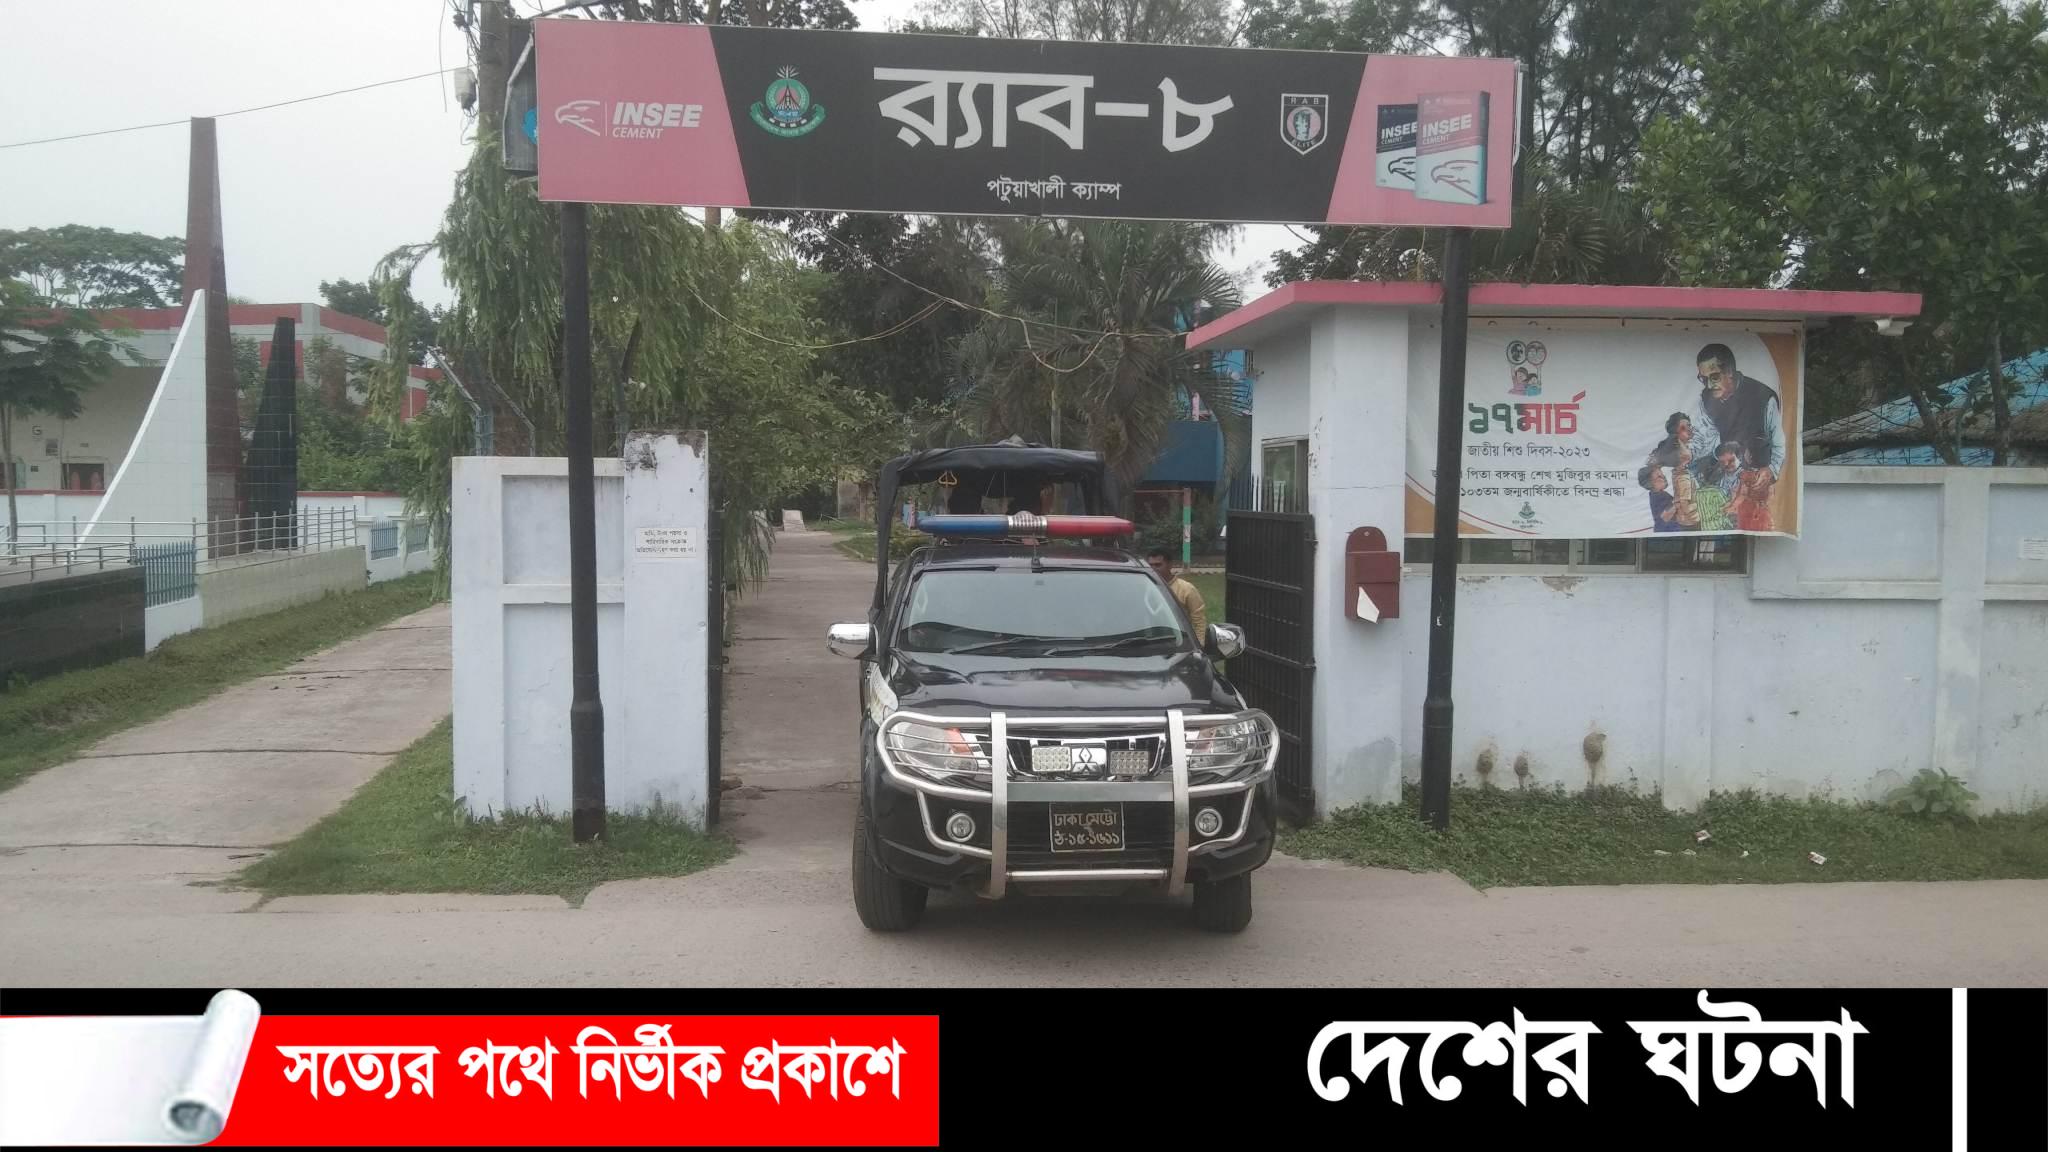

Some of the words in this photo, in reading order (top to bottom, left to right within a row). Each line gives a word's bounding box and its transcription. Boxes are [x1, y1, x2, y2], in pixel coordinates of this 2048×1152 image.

[612, 101, 703, 128] INSEE
[612, 127, 664, 139] CEMENT
[1421, 113, 1473, 138] INSEE
[1422, 134, 1450, 145] CEMENT
[986, 175, 1067, 203] পটুয়াখালী
[1070, 181, 1122, 201] ক্যাম্প
[1466, 441, 1500, 457] জাতীয়
[1502, 441, 1523, 457] শিশু
[1527, 441, 1591, 458] দিবস-২০২৩
[1466, 467, 1492, 480] পিতা
[1530, 470, 1552, 481] শেখ
[1555, 467, 1591, 482] মুজিবুর
[1594, 470, 1629, 481] রহমান
[1602, 487, 1625, 497] শ্রদ্ধা
[1054, 813, 1083, 827] ঢাকা
